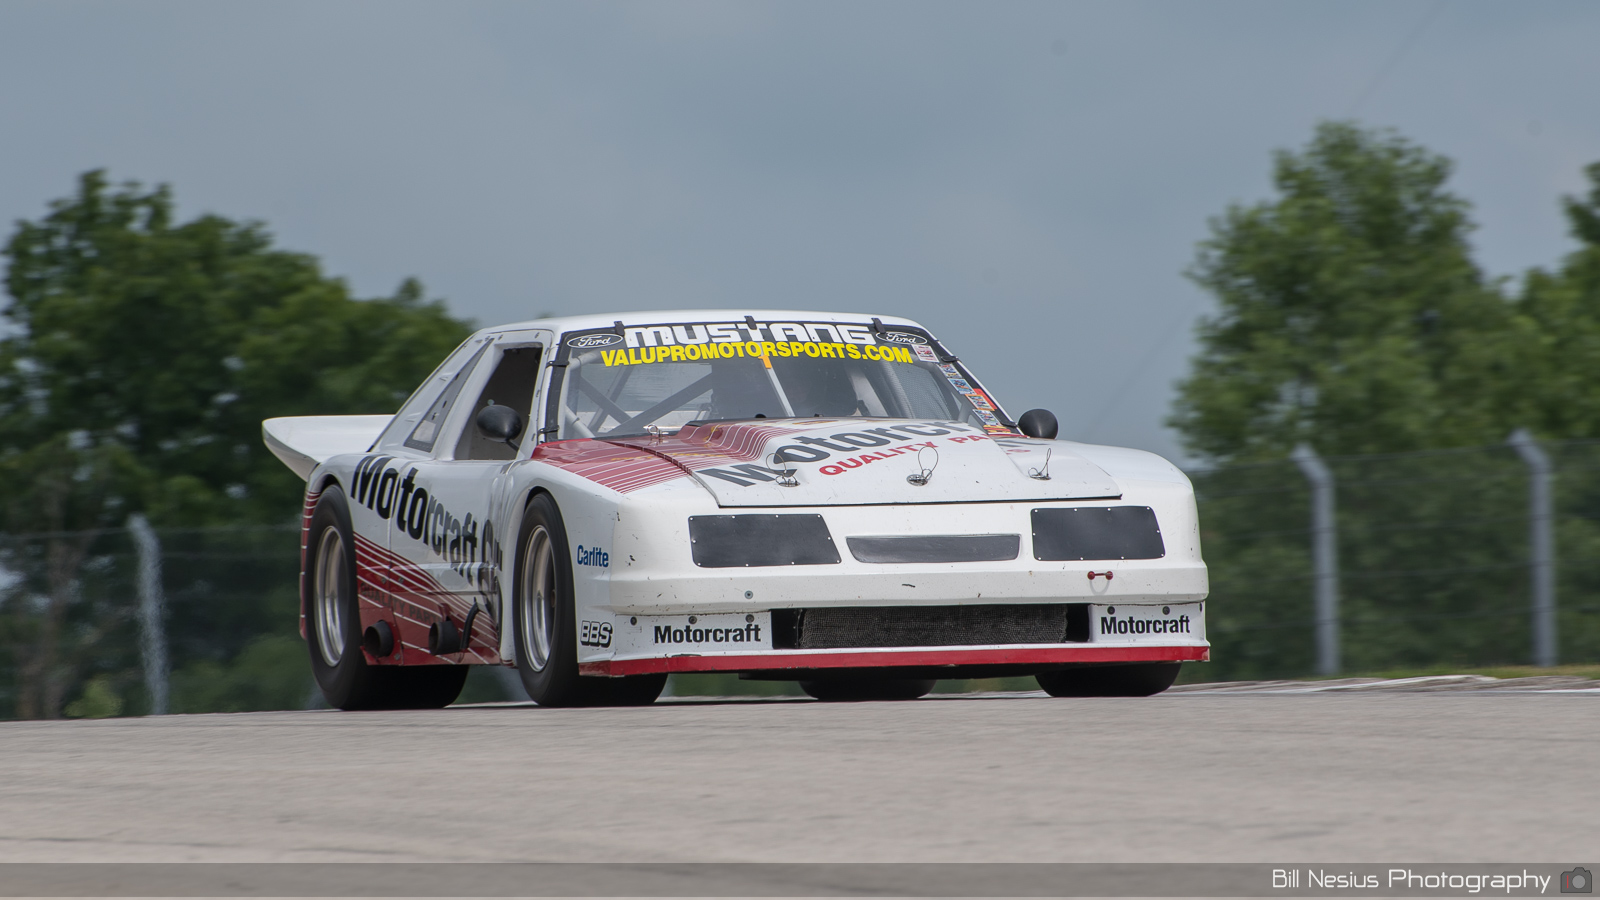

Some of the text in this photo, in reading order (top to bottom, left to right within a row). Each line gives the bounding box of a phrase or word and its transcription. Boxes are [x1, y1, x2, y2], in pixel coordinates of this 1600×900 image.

[575, 334, 614, 347] Ford
[624, 323, 877, 348] MUSTANG
[883, 332, 920, 345] Ford
[600, 341, 913, 367] VALUPROMOTORSPORTS.COM
[695, 422, 972, 488] Motorcr
[819, 441, 939, 476] QUALITY
[350, 454, 478, 587] Motorcraft
[577, 544, 609, 568] Carlite
[580, 620, 613, 648] BBS
[654, 623, 761, 644] Motorcraft
[1100, 615, 1190, 635] Motorcraft
